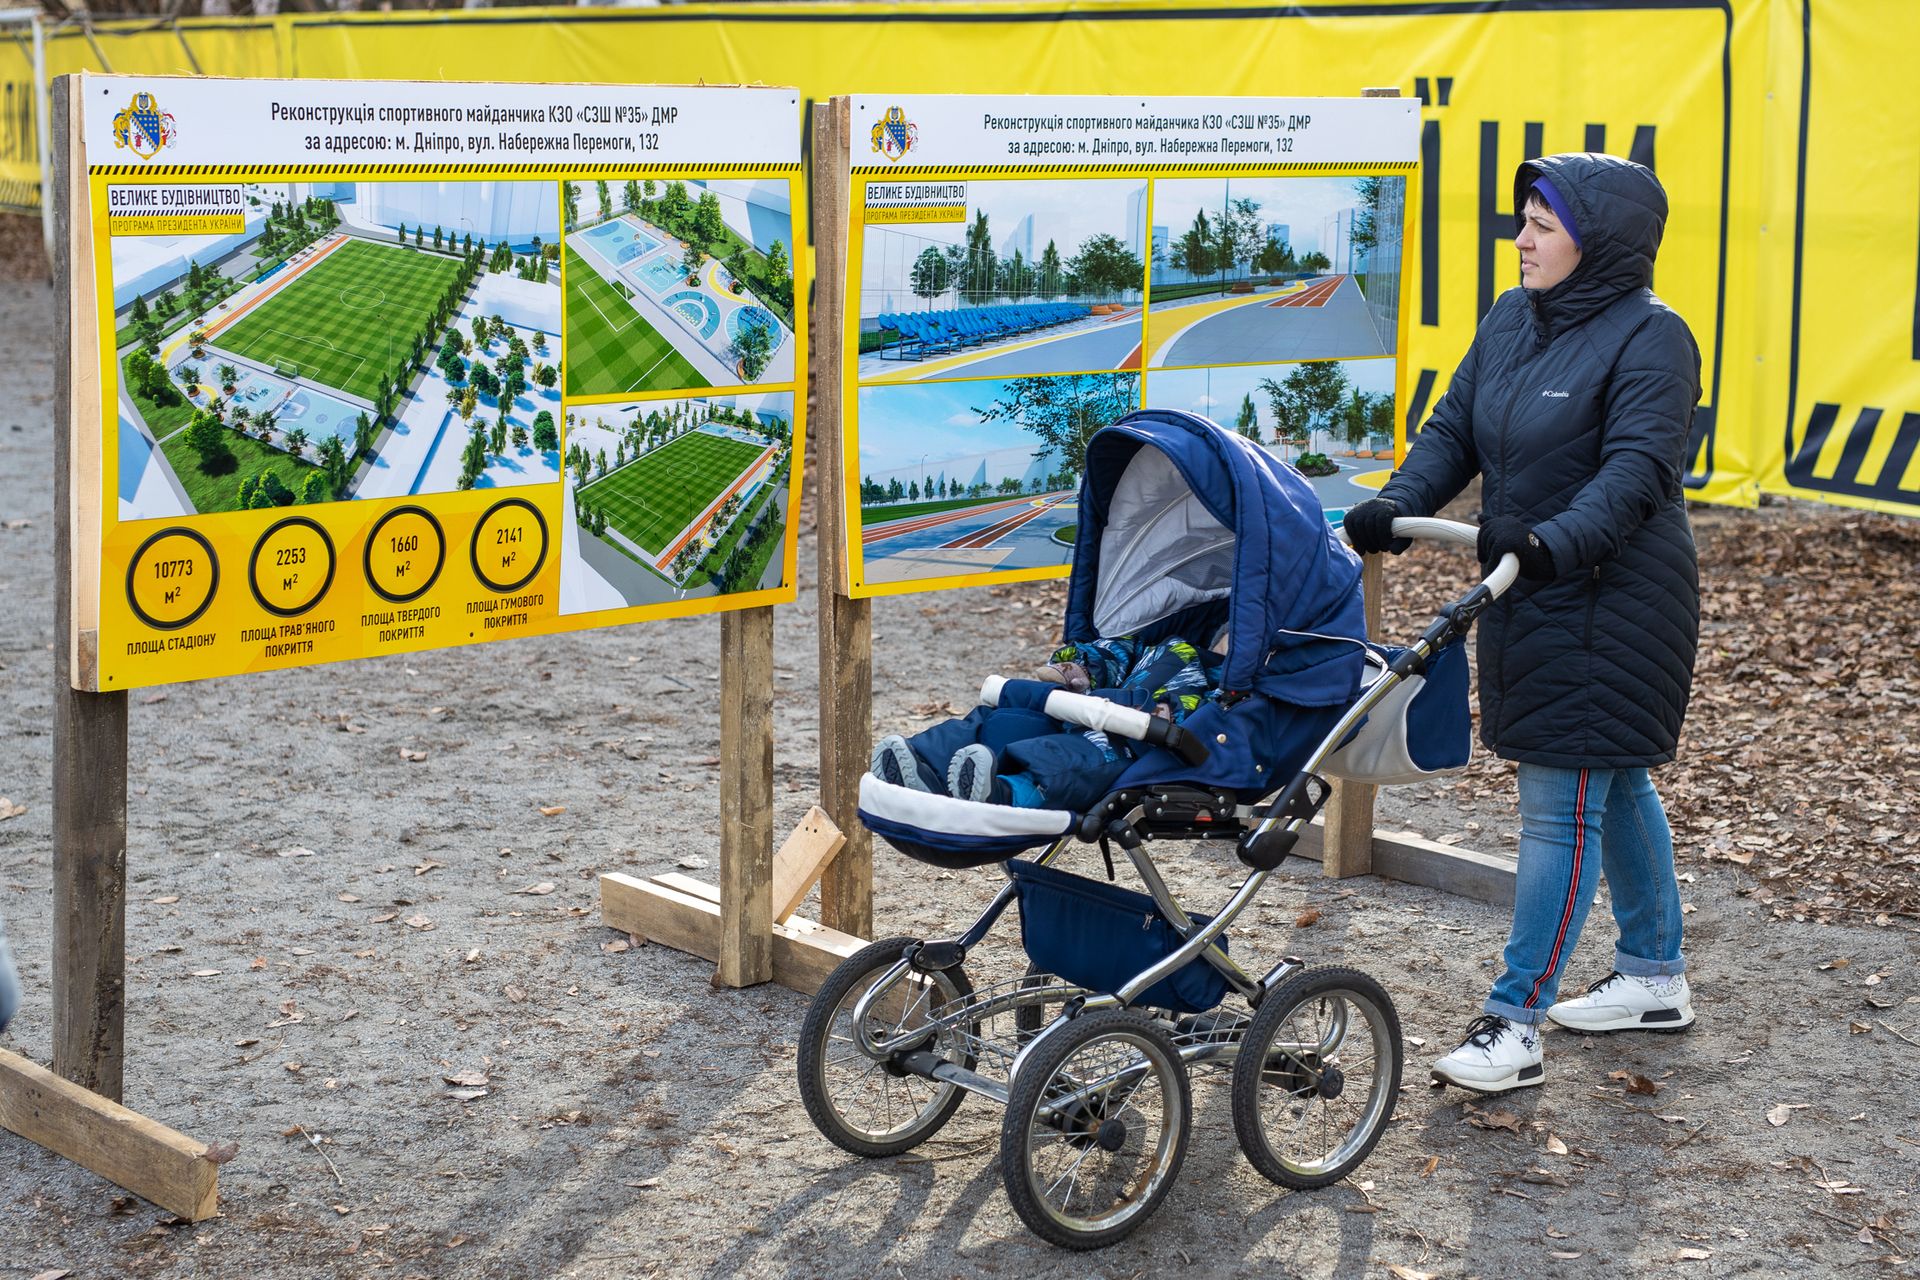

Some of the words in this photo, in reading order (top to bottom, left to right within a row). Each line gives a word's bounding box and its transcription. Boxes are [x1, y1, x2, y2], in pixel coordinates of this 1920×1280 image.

[272, 103, 374, 125] Реконструкція
[379, 108, 462, 125] спортивного
[467, 105, 544, 125] майданчика
[549, 106, 572, 122] КЗО
[577, 106, 610, 123] «СЗШ
[615, 107, 648, 123] №35»
[652, 107, 677, 126] ДМР
[985, 114, 1063, 133] Реконструкція
[1067, 118, 1132, 132] спортивного
[1136, 115, 1199, 131] майданчика
[1203, 115, 1222, 129] КЗО
[1226, 115, 1254, 129] «СЗШ
[1258, 115, 1285, 129] №35»
[1288, 115, 1310, 131] ДМР
[305, 136, 320, 149] за
[325, 136, 391, 154] адресою:
[396, 137, 409, 149] м.
[414, 132, 463, 154] Дніпро,
[468, 137, 494, 153] вул.
[499, 133, 569, 154] Набережна
[574, 133, 635, 154] Перемоги,
[639, 134, 658, 149] 132
[1008, 142, 1020, 153] за
[1024, 142, 1074, 157] адресою:
[1079, 142, 1089, 153] м.
[1092, 138, 1131, 156] Дніпро,
[1136, 142, 1156, 156] вул.
[1161, 138, 1218, 156] Набережна
[1222, 138, 1272, 155] Перемоги,
[1277, 138, 1293, 152] 132
[112, 190, 158, 205] ВЕЛИКЕ
[162, 189, 241, 208] БУДІВНИЦТВО
[868, 186, 902, 199] ВЕЛИКЕ
[905, 186, 964, 201] БУДІВНИЦТВО
[113, 220, 154, 231] ПРОГРАМА
[158, 219, 207, 231] ПРЕЗИДЕНТА
[209, 217, 242, 231] УКРАЇНИ
[866, 211, 897, 221] ПРОГРАМА
[900, 210, 937, 221] ПРЕЗИДЕНТА
[939, 209, 964, 220] УКРАЇНИ
[391, 536, 417, 552] 1660
[497, 527, 521, 544] 2141
[277, 548, 305, 566] 2253
[155, 560, 192, 578] 10773
[467, 600, 498, 614] ПЛОЩА
[501, 593, 543, 609] ГУМОВОГО
[362, 612, 394, 626] ПЛОЩА
[397, 607, 440, 622] ТВЕРДОГО
[485, 613, 527, 629] ПОКРИТТЯ
[241, 627, 276, 642] ПЛОЩА
[379, 626, 424, 642] ПОКРИТТЯ
[128, 640, 165, 655] ПЛОЩА
[168, 633, 216, 650] СТАДІОНУ
[265, 640, 313, 657] ПОКРИТТЯ
